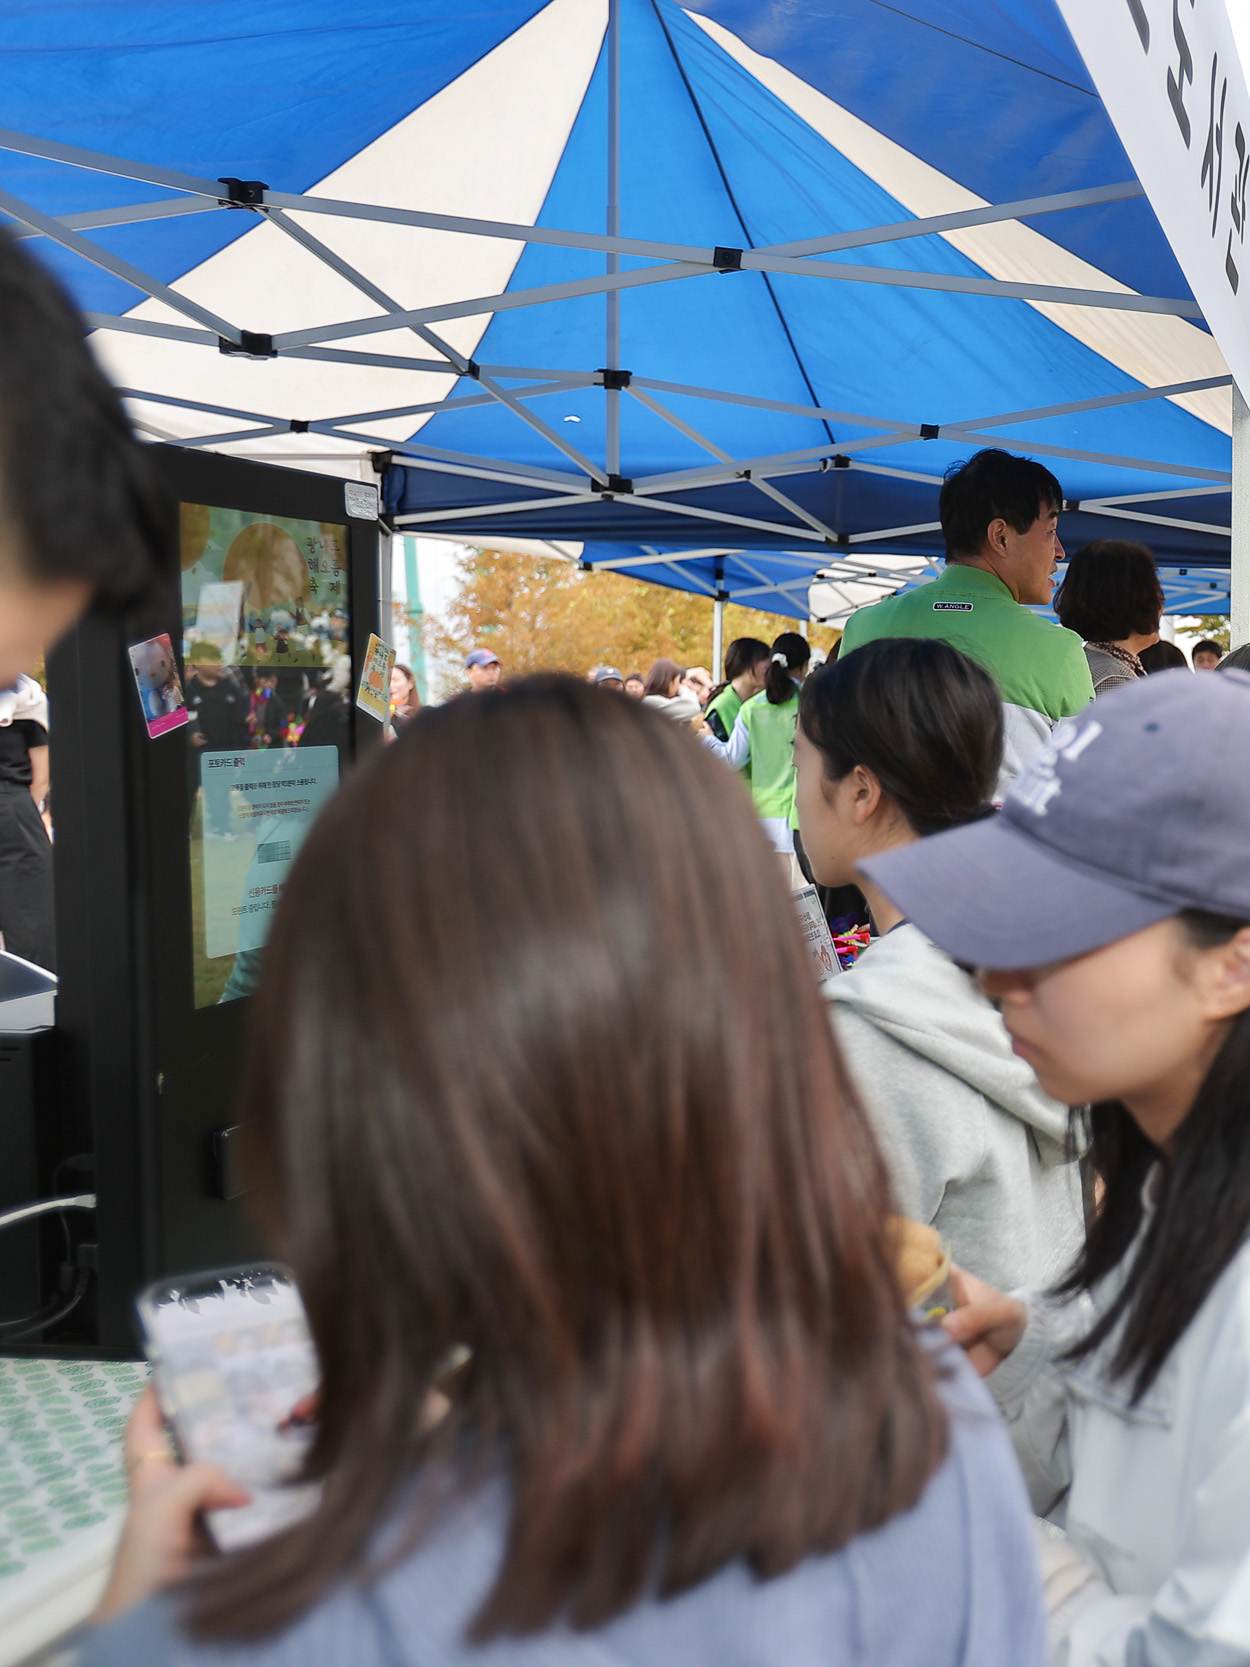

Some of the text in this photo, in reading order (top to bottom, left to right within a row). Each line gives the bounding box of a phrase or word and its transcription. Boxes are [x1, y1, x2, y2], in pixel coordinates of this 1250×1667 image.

[1126, 0, 1250, 296] 도서관
[306, 536, 340, 554] 광나루
[308, 557, 341, 577] 해오름
[208, 757, 245, 768] 포토카드 출력
